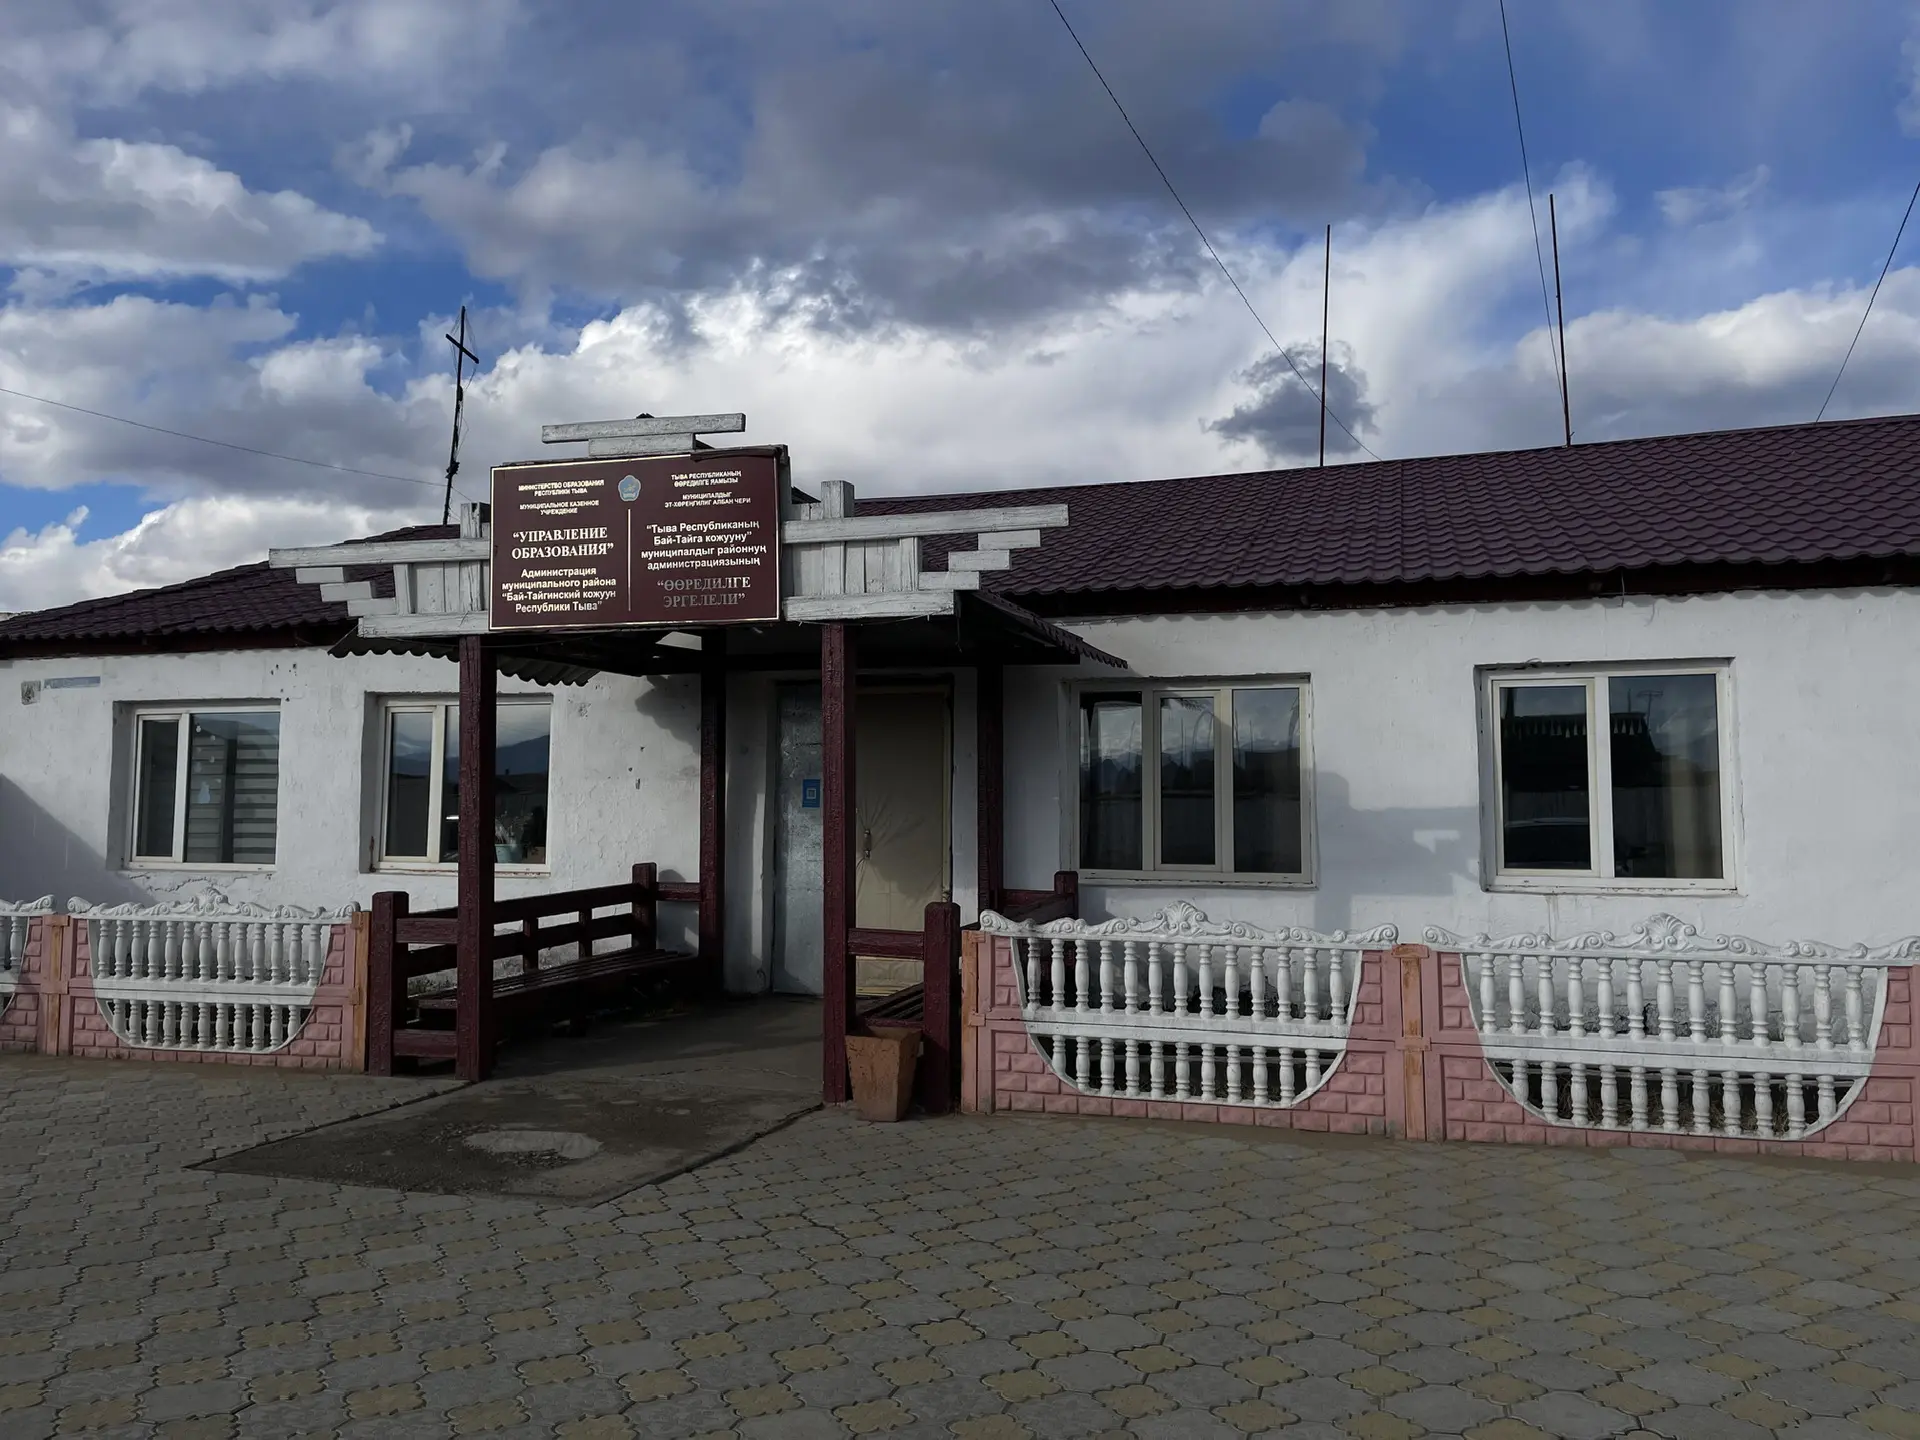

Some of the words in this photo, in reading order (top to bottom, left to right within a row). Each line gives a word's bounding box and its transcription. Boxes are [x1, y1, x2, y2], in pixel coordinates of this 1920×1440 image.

[518, 481, 562, 491] МИНИСТЕРСТВО
[563, 479, 605, 488] ОБРАЗОВАНИЯ
[534, 489, 571, 497] РЕСПУБЛИКИ
[519, 501, 569, 510] МУНИЦИПАЛЬНОЕ
[540, 508, 578, 516] УЧРЕЖДЕНИЕ
[646, 524, 677, 534] “Тыва
[680, 520, 760, 532] Республиканың
[512, 527, 608, 543] “УПРАВЛЕНИЕ
[653, 534, 703, 546] Бай-Тайга
[705, 531, 752, 543] кожууну”
[511, 543, 614, 560] ОБРАЗОВАНИЯ”
[641, 547, 715, 560] муниципалдыг
[717, 544, 767, 555] районнуң
[647, 557, 761, 570] администрациязының
[521, 567, 597, 578] Администрация
[502, 579, 580, 591] муниципального
[582, 577, 616, 588] района
[502, 590, 580, 602] “Бай-Тайгинский
[582, 590, 616, 600] кожуун
[663, 593, 746, 608] ЭРГЕЛЕЛИ”
[515, 603, 570, 614] Республики
